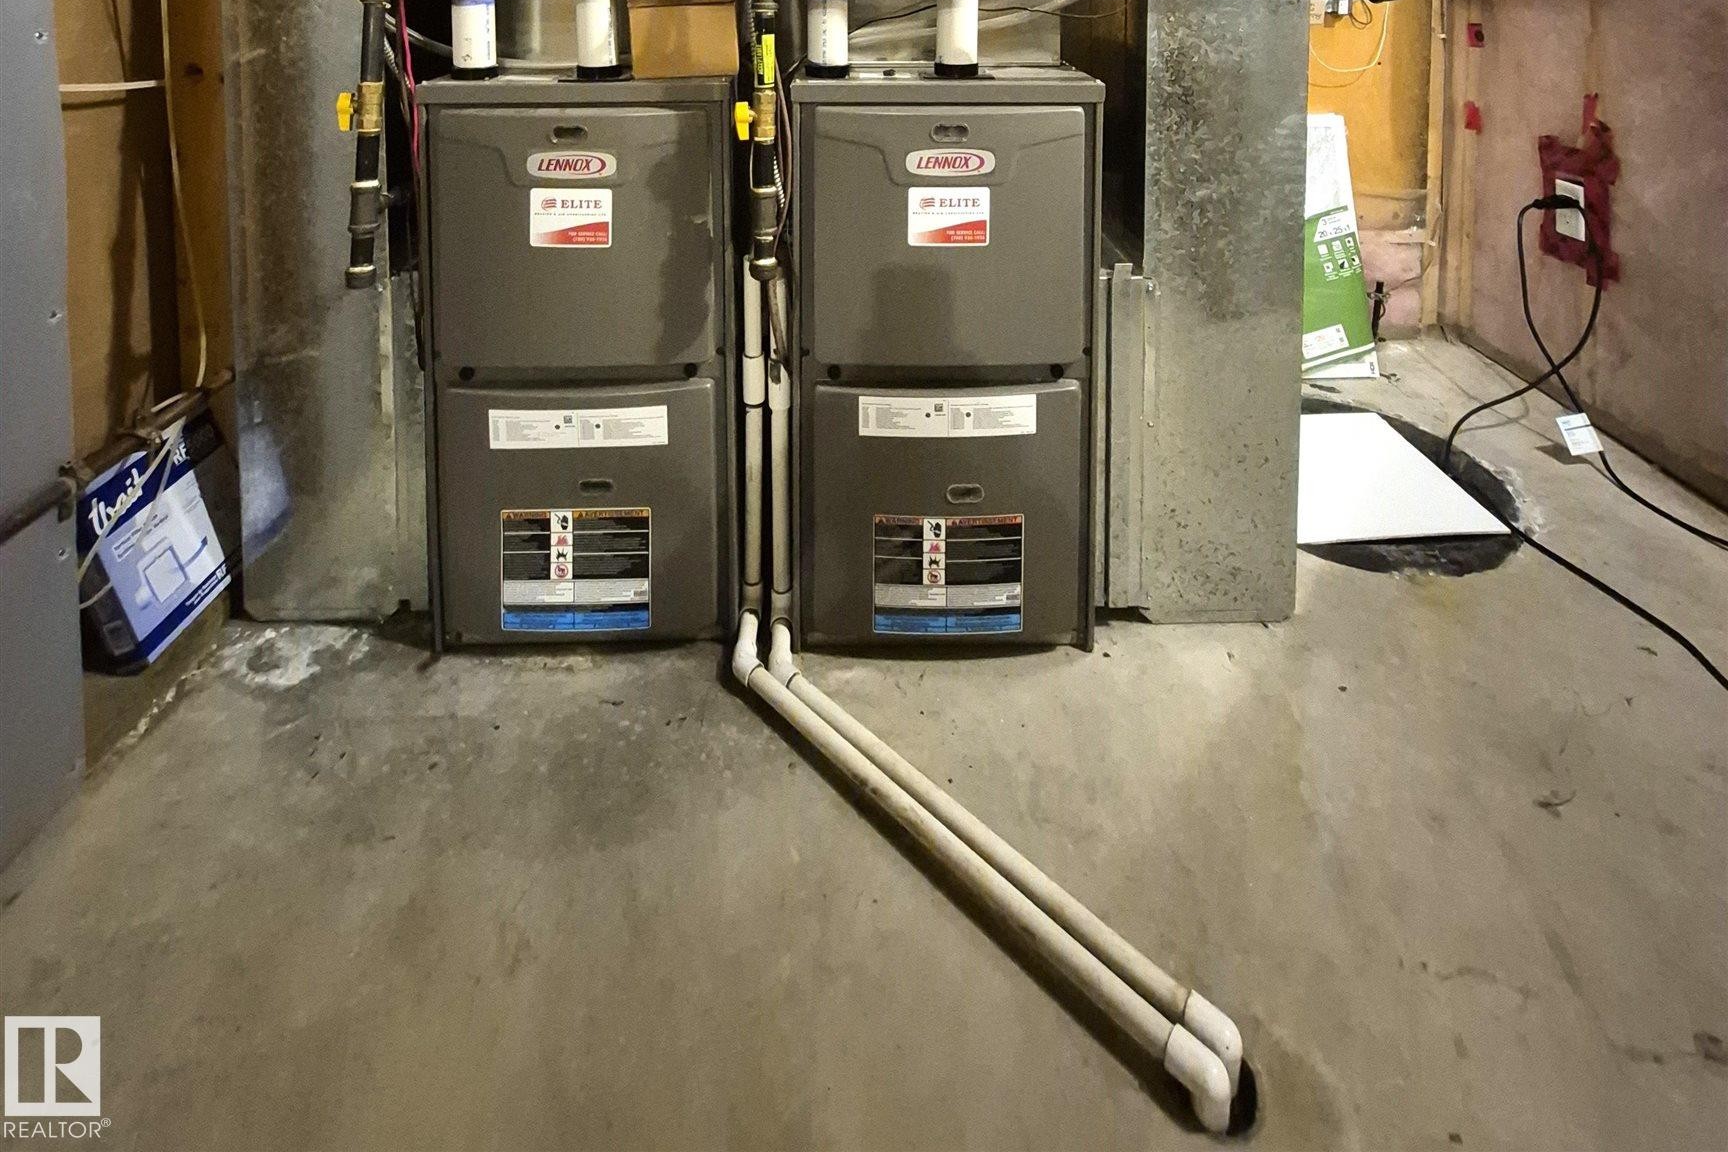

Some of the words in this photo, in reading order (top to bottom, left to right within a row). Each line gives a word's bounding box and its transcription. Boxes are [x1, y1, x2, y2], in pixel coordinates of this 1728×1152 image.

[537, 158, 594, 172] LENNOX
[916, 155, 973, 170] LENNOX
[560, 199, 603, 209] ELITE
[939, 198, 981, 208] ELITE
[1321, 218, 1328, 226] 3
[1332, 225, 1344, 235] 25
